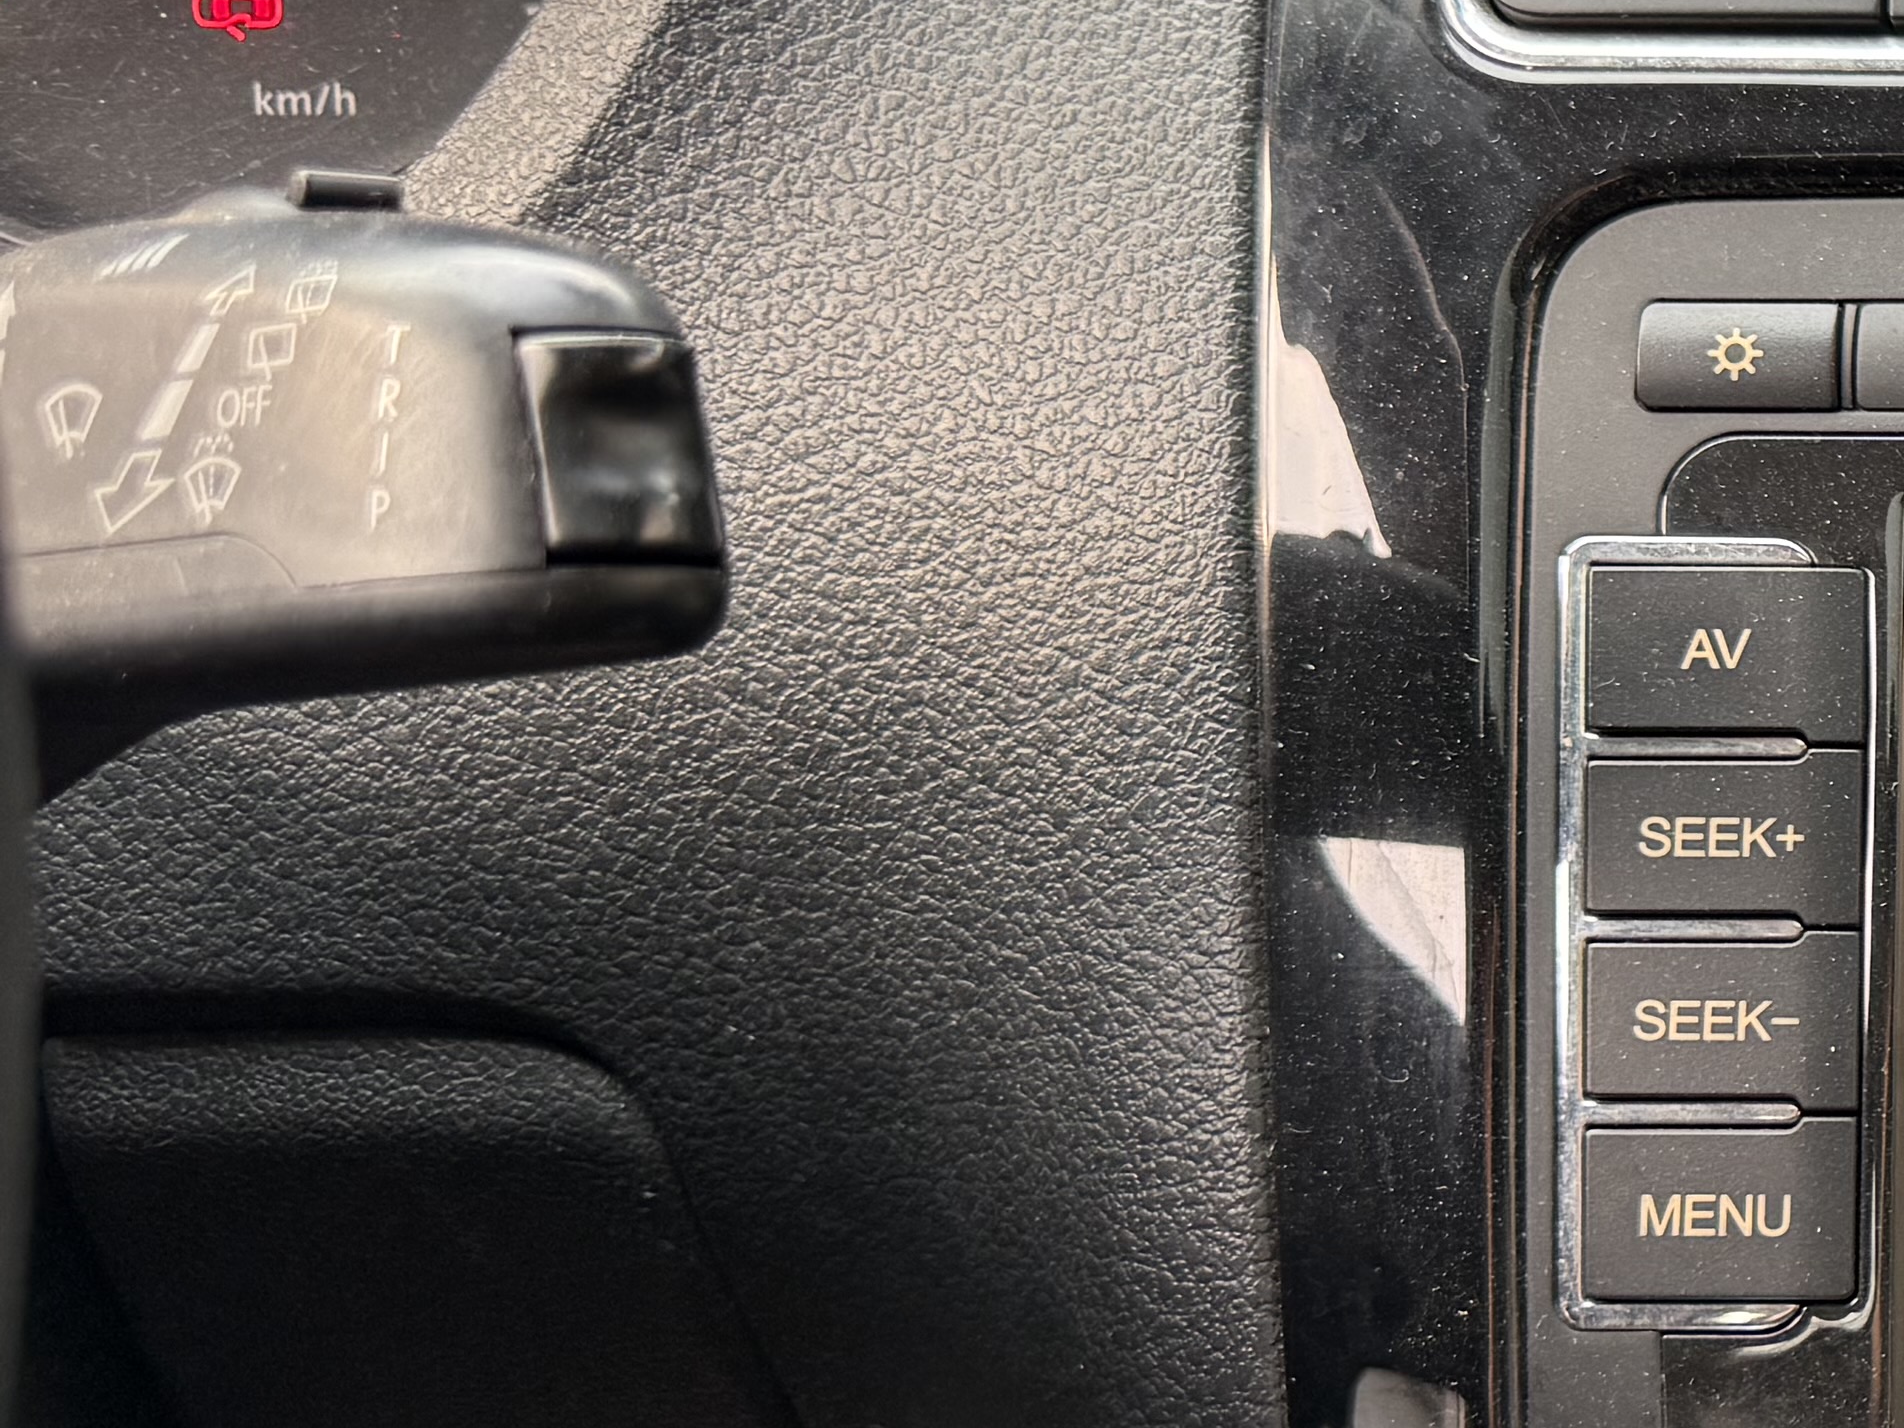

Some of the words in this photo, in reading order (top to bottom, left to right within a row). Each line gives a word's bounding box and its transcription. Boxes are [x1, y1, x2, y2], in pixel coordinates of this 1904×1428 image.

[253, 82, 356, 115] km/h
[217, 384, 273, 427] OFF
[1681, 629, 1751, 669] AV
[1638, 817, 1804, 857] SEEK+
[1633, 1000, 1799, 1041] SEEK-
[1639, 1194, 1790, 1237] MENU
